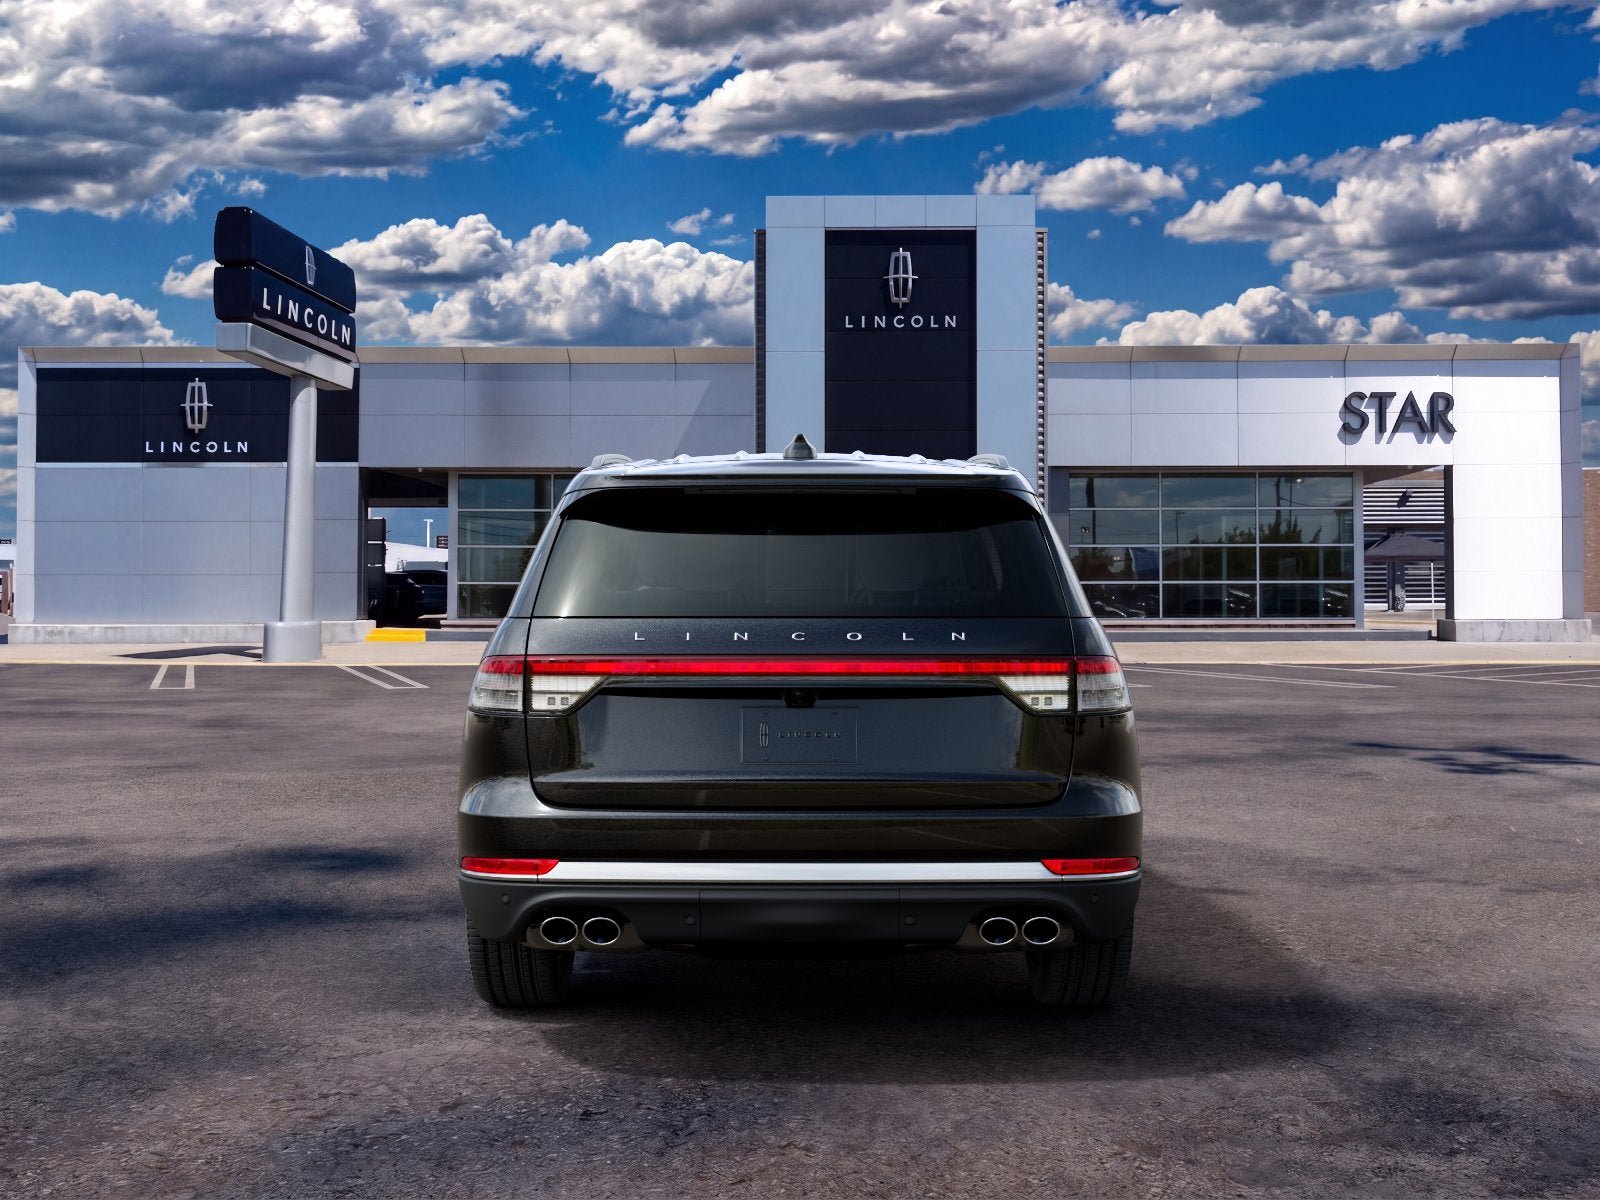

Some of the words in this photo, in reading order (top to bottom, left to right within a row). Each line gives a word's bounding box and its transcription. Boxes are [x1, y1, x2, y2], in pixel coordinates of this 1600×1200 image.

[262, 287, 351, 346] LINCOLN
[845, 315, 957, 328] LINCOLN
[1341, 390, 1458, 435] STAR
[145, 441, 248, 453] LINCOLN
[634, 631, 966, 642] LINCOLN
